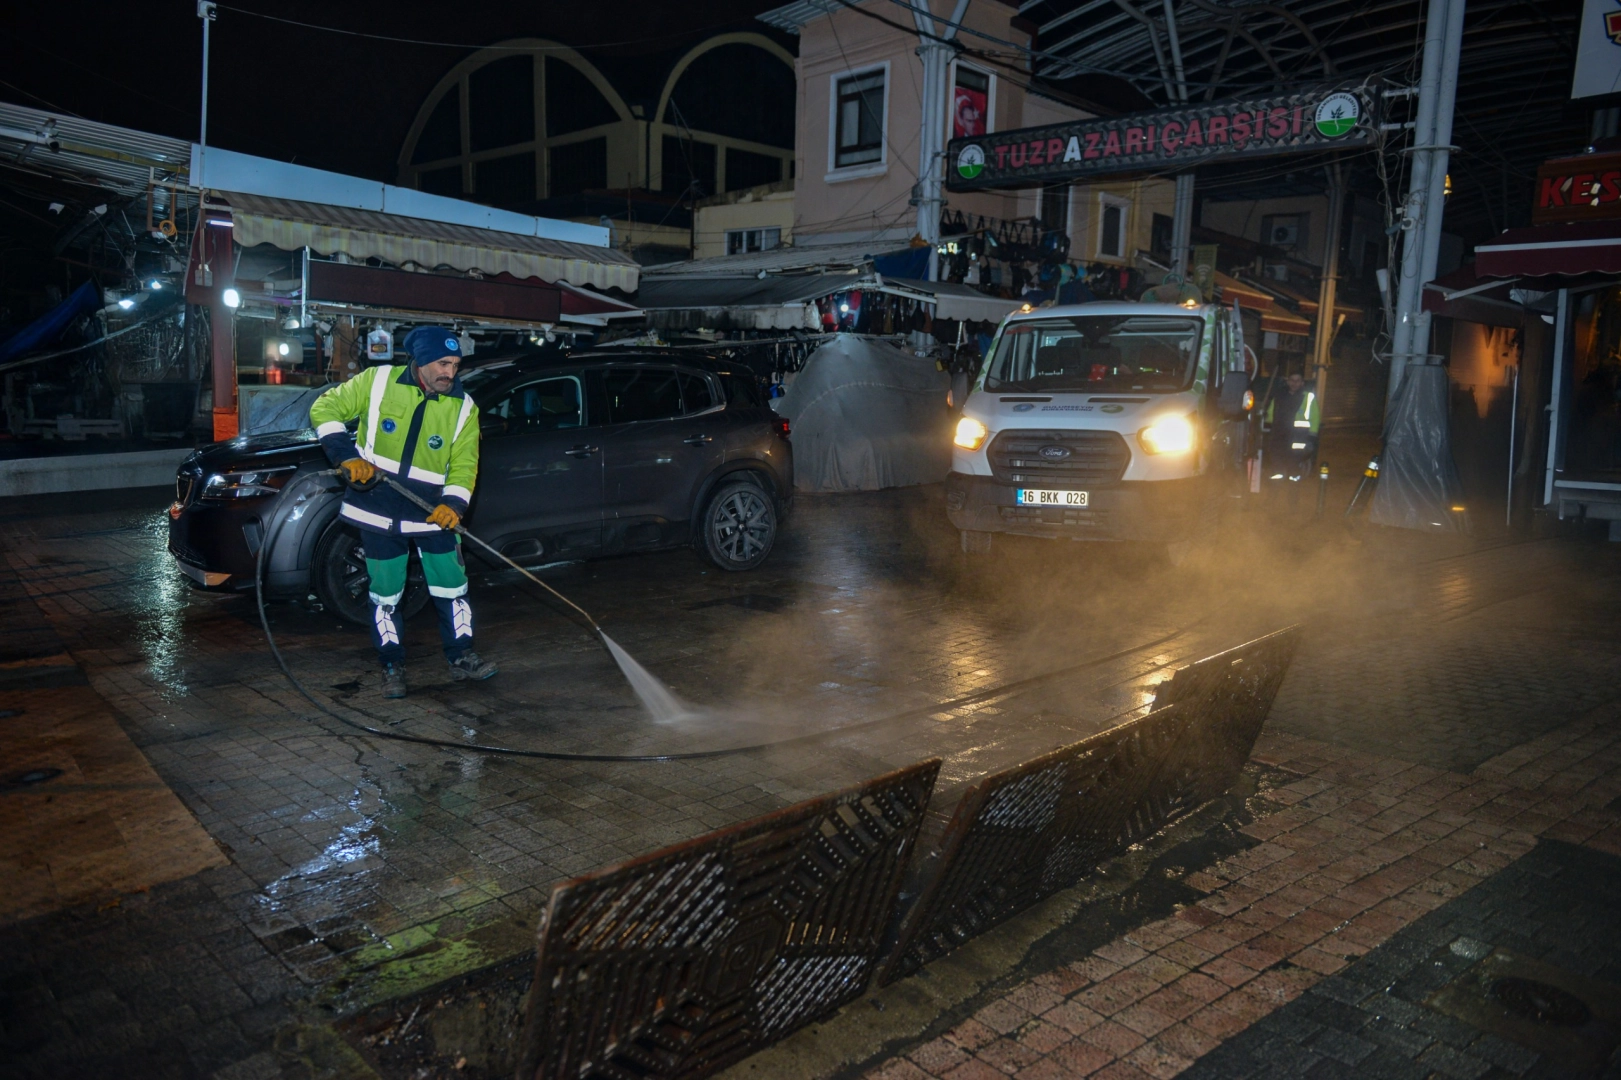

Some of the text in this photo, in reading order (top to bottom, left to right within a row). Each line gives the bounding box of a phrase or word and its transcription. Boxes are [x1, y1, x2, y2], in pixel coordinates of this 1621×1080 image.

[994, 124, 1155, 170] TUZPAZARI
[1161, 105, 1304, 157] ÇARŞISI
[1045, 448, 1064, 456] Ford
[1023, 490, 1086, 505] 16 BKK 028
